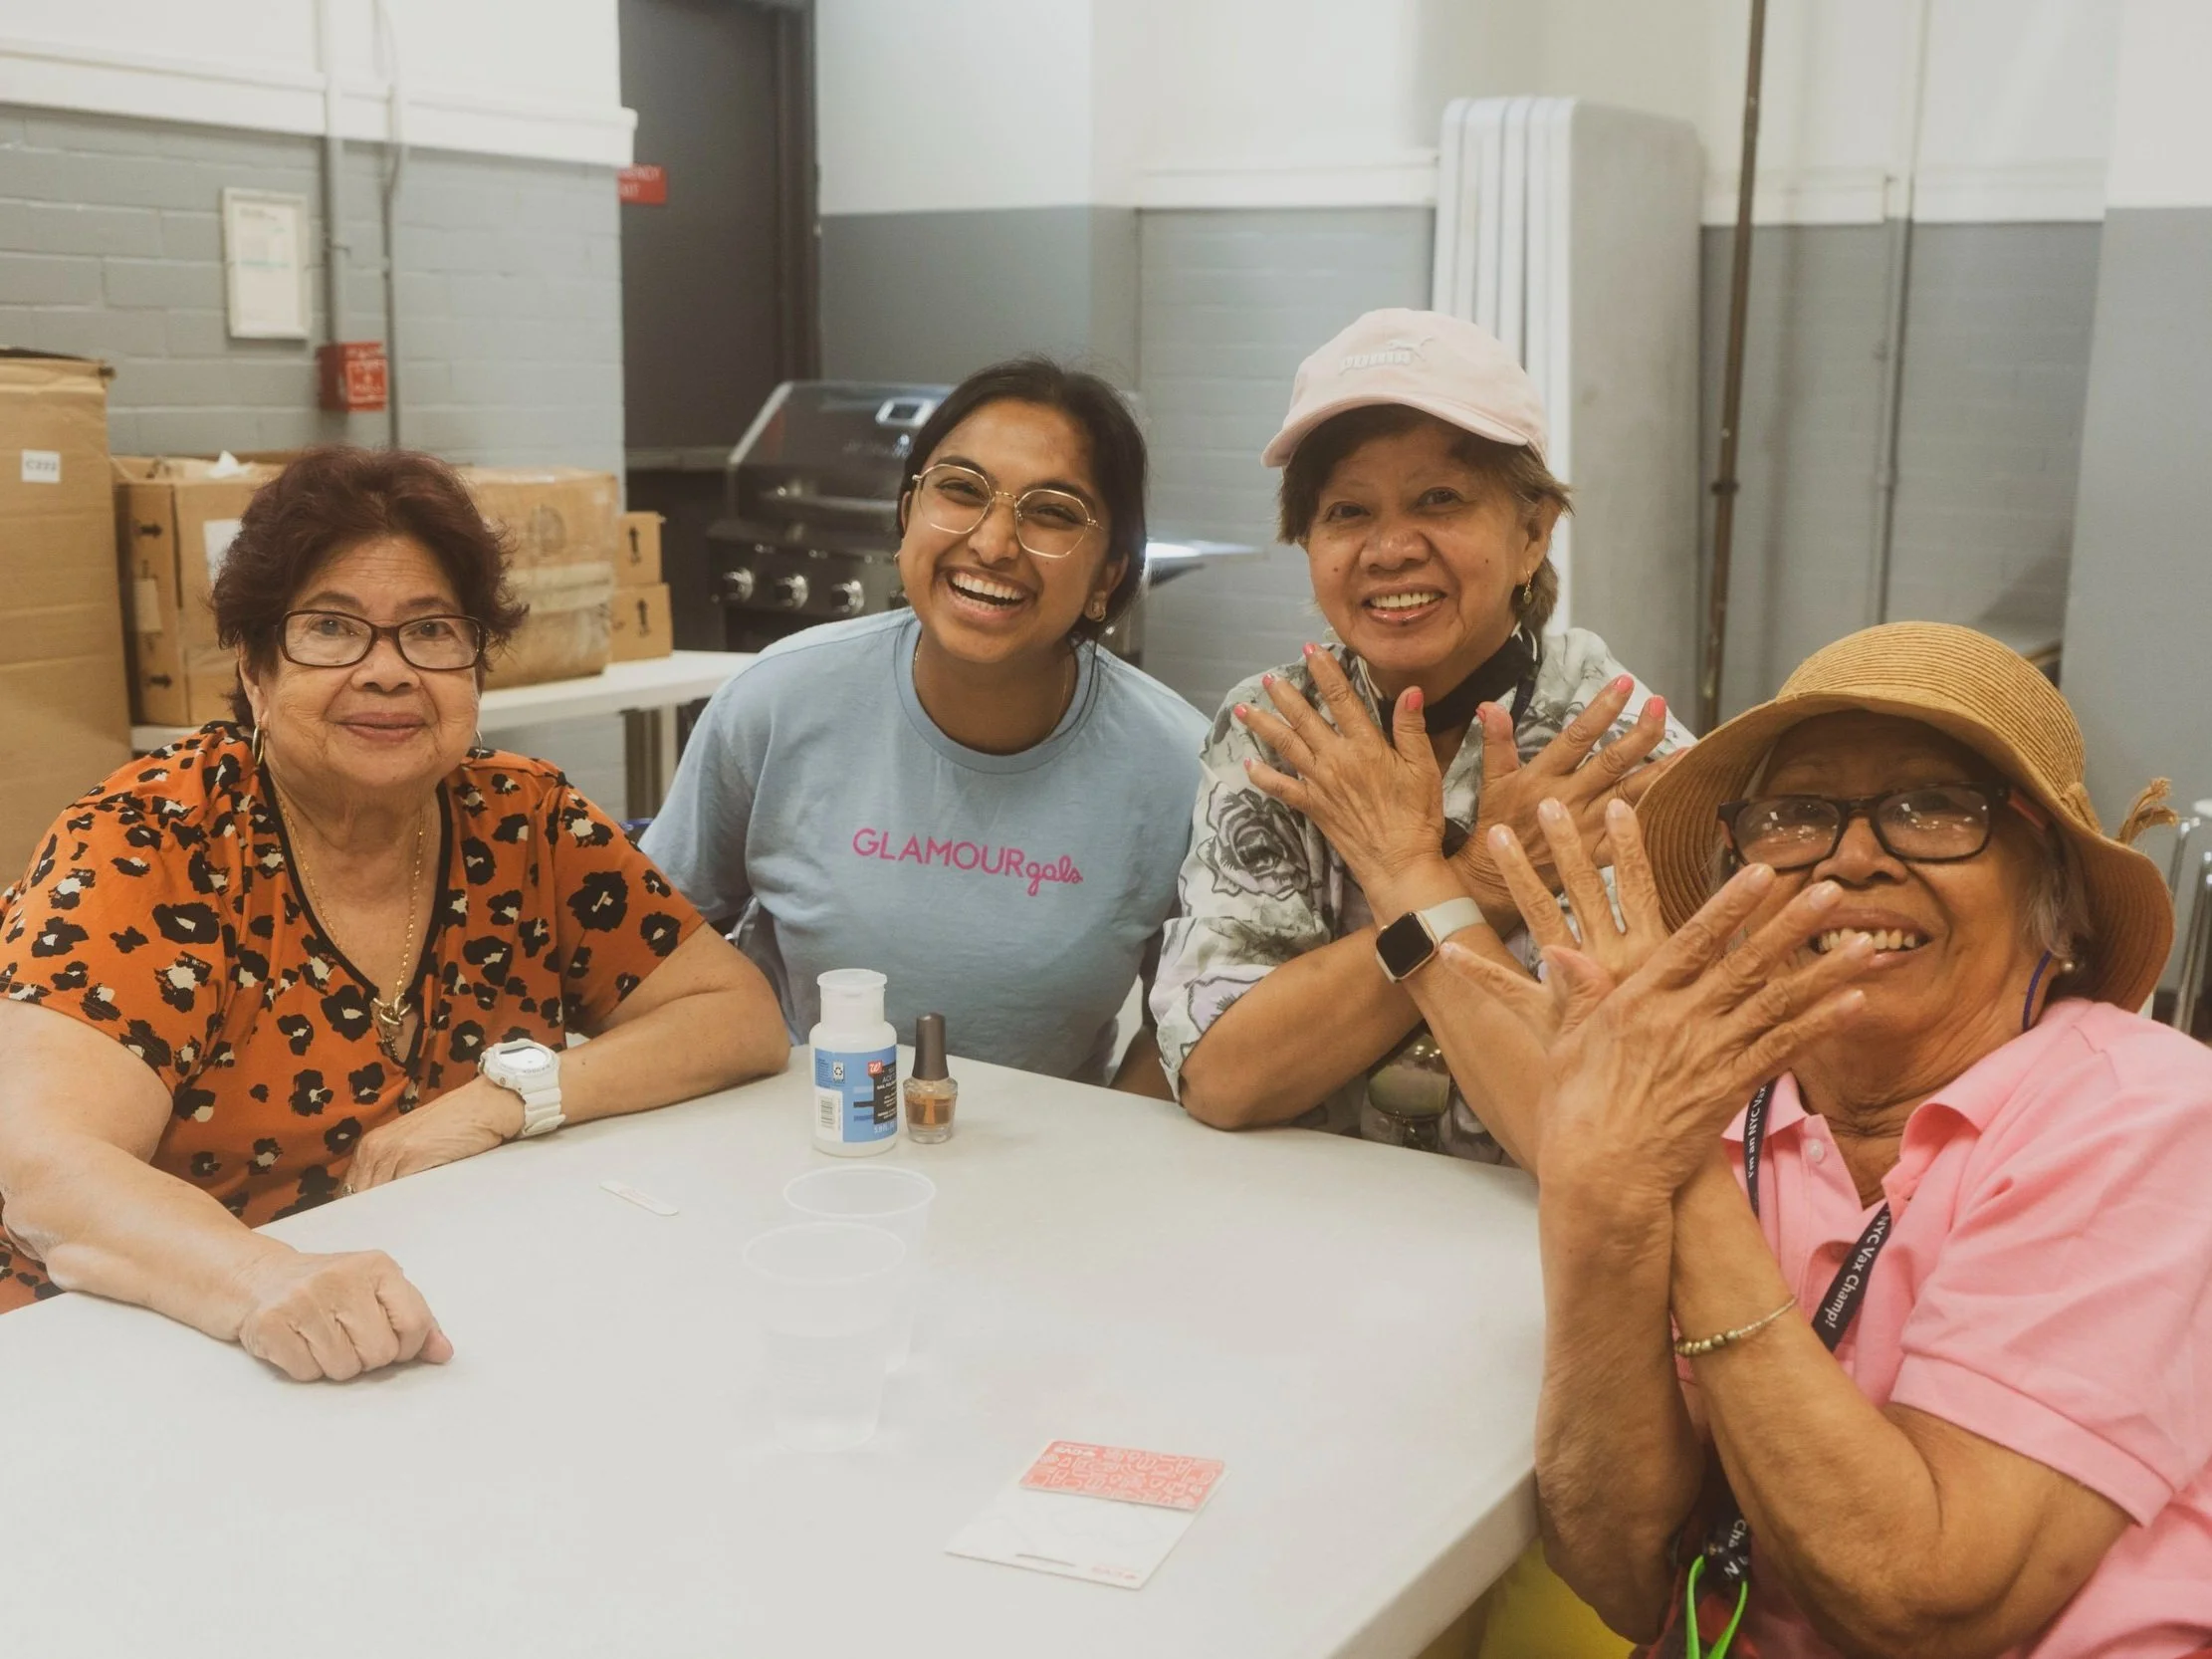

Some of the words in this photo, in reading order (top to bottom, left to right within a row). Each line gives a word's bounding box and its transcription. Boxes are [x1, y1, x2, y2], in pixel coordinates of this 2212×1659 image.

[1752, 1085, 1766, 1108] Vax
[1748, 1107, 1760, 1136] NYC
[1748, 1137, 1755, 1154] an
[1867, 1215, 1889, 1245] NYC
[1852, 1247, 1876, 1272] Vax
[1824, 1275, 1860, 1328] Champ!
